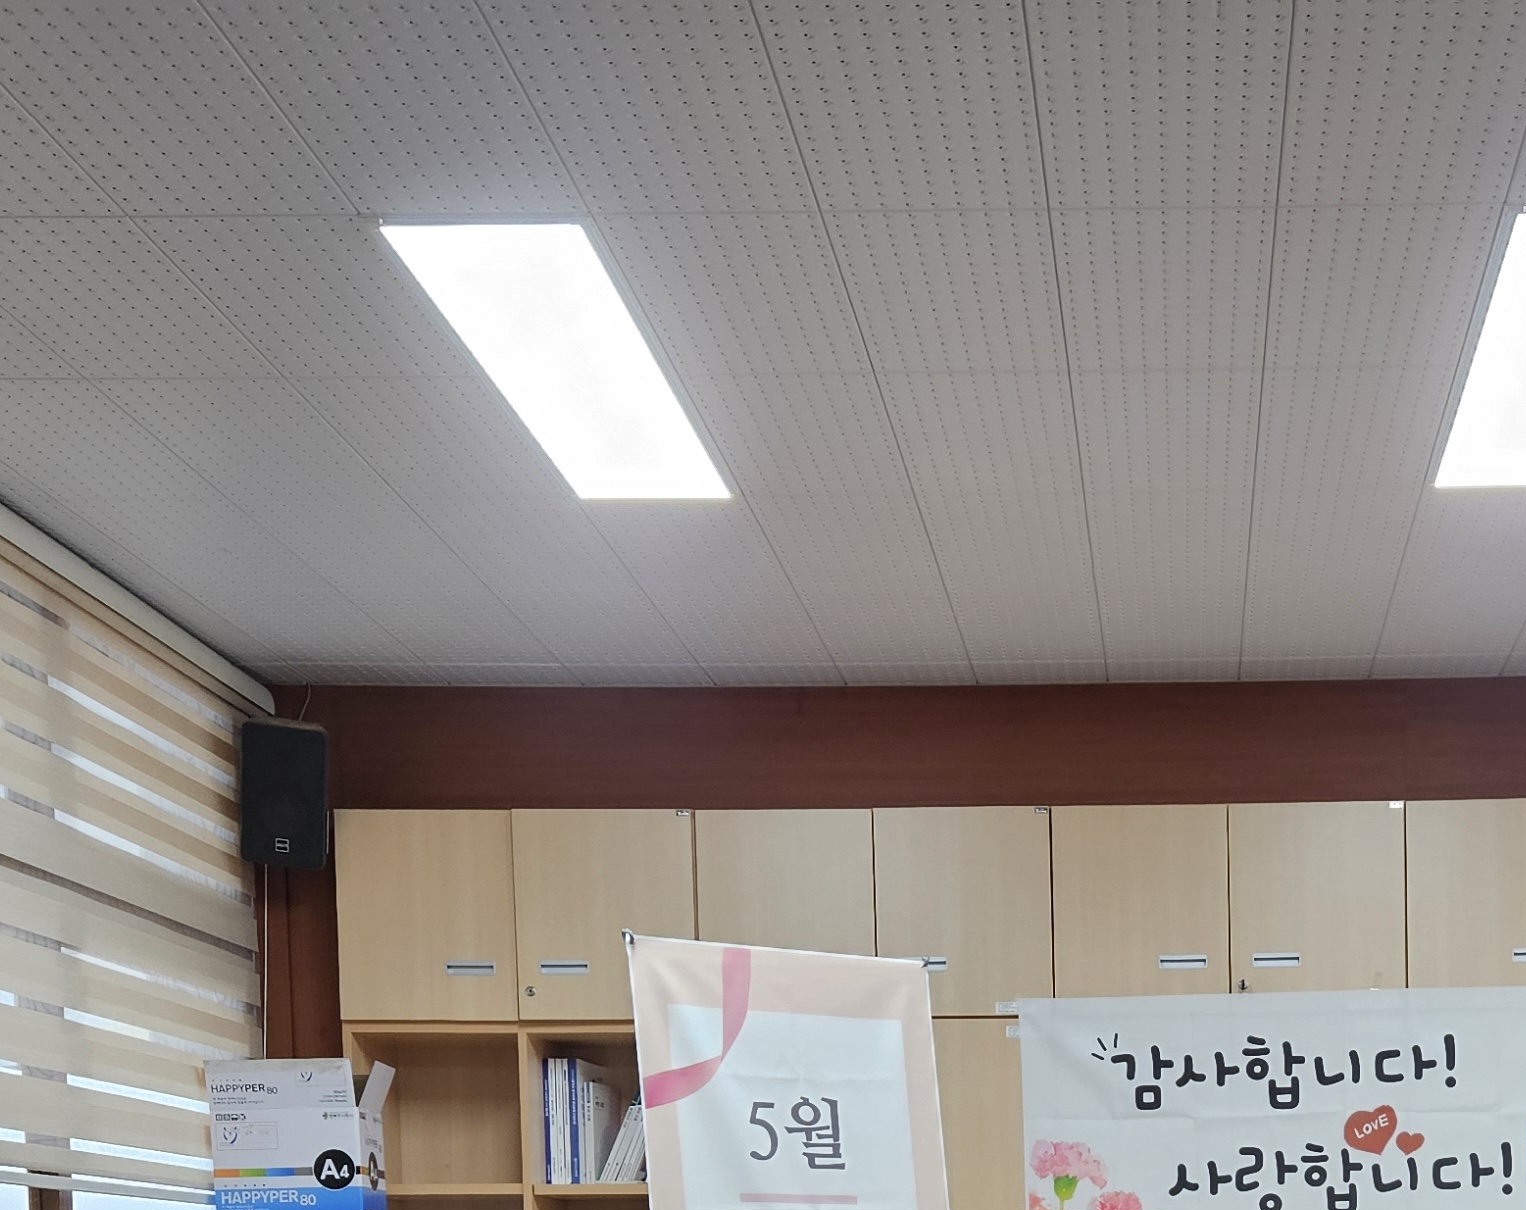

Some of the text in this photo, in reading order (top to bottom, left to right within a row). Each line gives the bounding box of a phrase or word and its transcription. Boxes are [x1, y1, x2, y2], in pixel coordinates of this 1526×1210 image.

[1110, 1034, 1457, 1110] 감사합니다!
[210, 1083, 278, 1095] HAPPYPER 80
[749, 1096, 846, 1171] 5월
[1354, 1113, 1390, 1139] LOVE
[320, 1158, 350, 1180] A4
[220, 1190, 317, 1206] HAPPYPER 80
